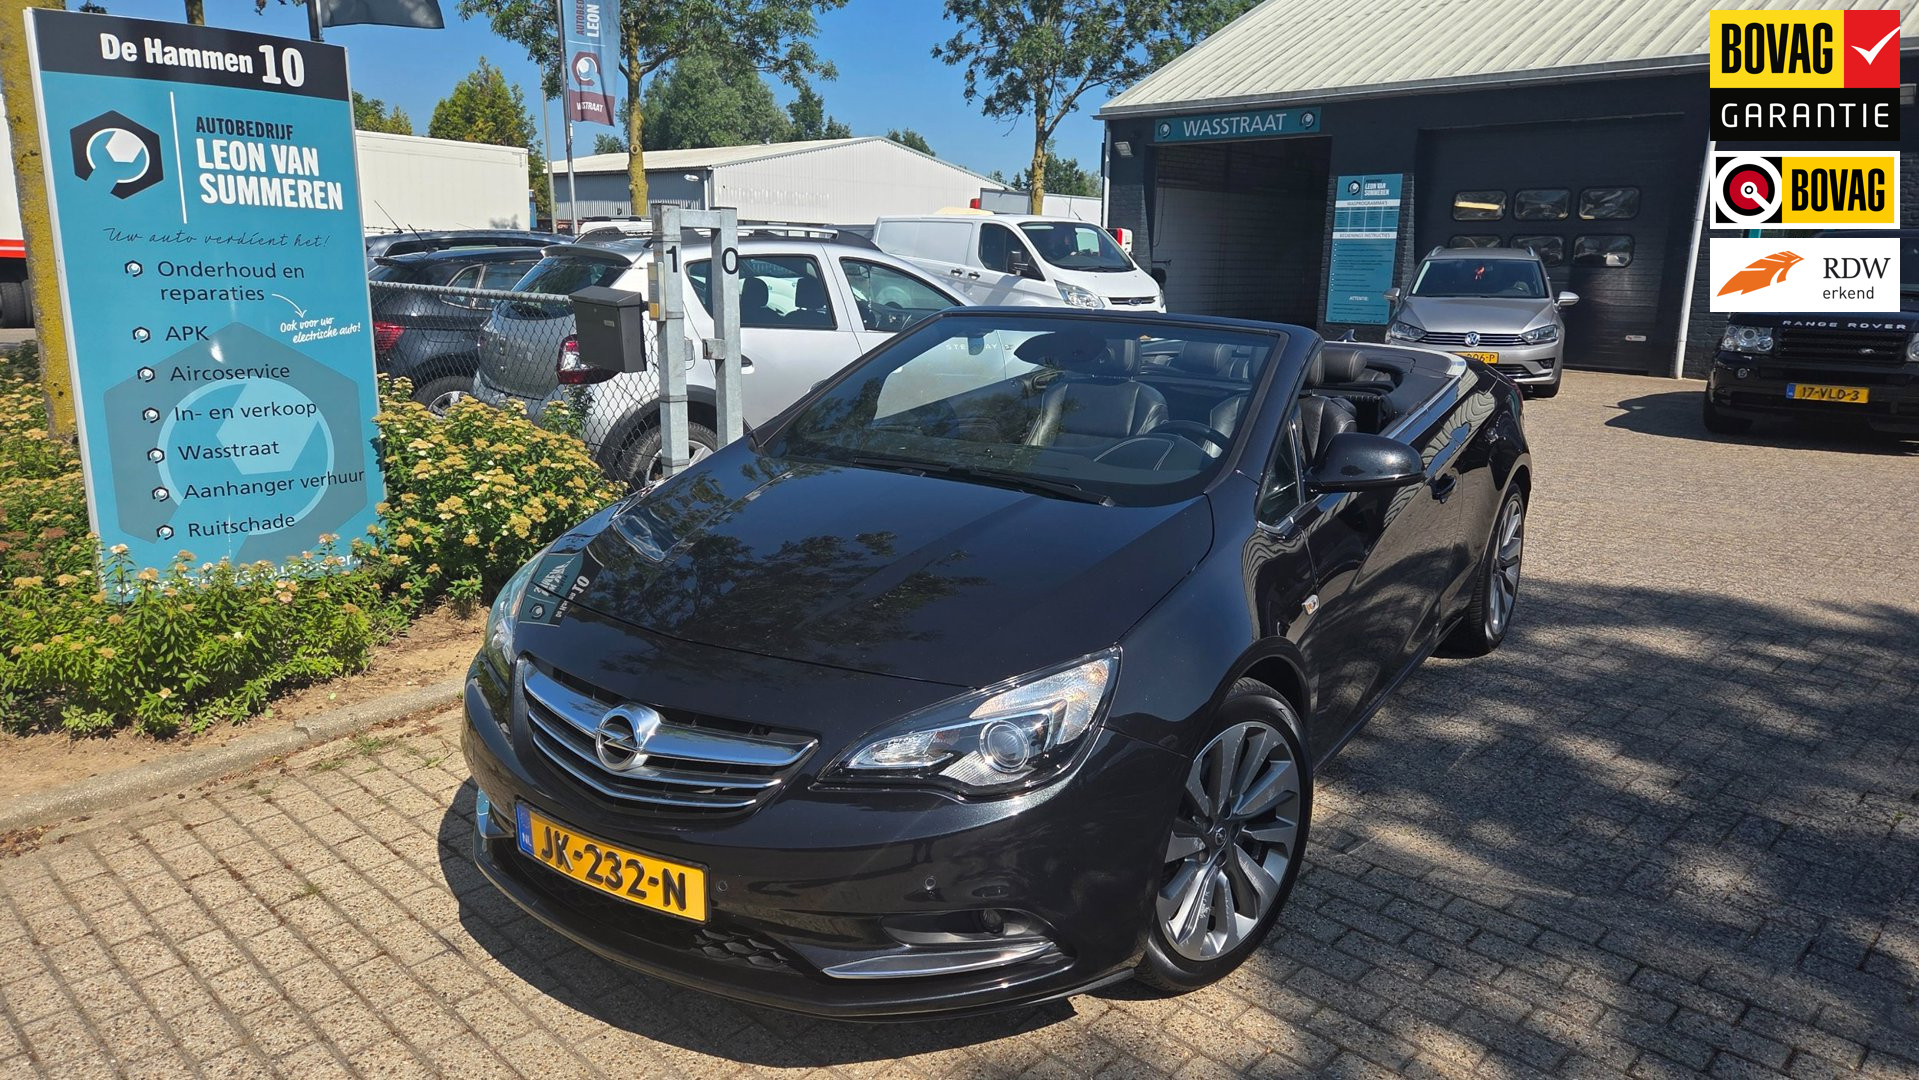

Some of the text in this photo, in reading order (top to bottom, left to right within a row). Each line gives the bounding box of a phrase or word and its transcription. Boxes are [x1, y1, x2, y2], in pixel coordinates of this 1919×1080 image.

[587, 4, 600, 38] LEON
[100, 33, 305, 88] De Hammen 10
[196, 115, 293, 141] AUTOBEDRIJF
[1183, 113, 1287, 137] WASSTRAAT
[196, 138, 320, 177] LEON VAN
[199, 173, 343, 211] SUMMEREN
[103, 227, 331, 248] Uw auto verdient het!
[158, 260, 305, 279] Onderhoud en
[665, 245, 678, 273] 1
[160, 285, 265, 305] reparaties
[165, 326, 211, 342] APK
[280, 316, 334, 333] Ook voor uw
[292, 322, 361, 344] electrische auto!
[1782, 320, 1907, 330] RANGE ROVER
[170, 365, 290, 382] Aircoservice
[1802, 386, 1860, 400] 17-VLD-3
[174, 401, 317, 422] In- en verkoop
[178, 441, 280, 461] Wasstraat
[184, 469, 365, 500] Aanhanger verhuur
[188, 514, 296, 538] Ruitschade
[522, 832, 532, 847] NL
[541, 826, 687, 912] JK-232-N
